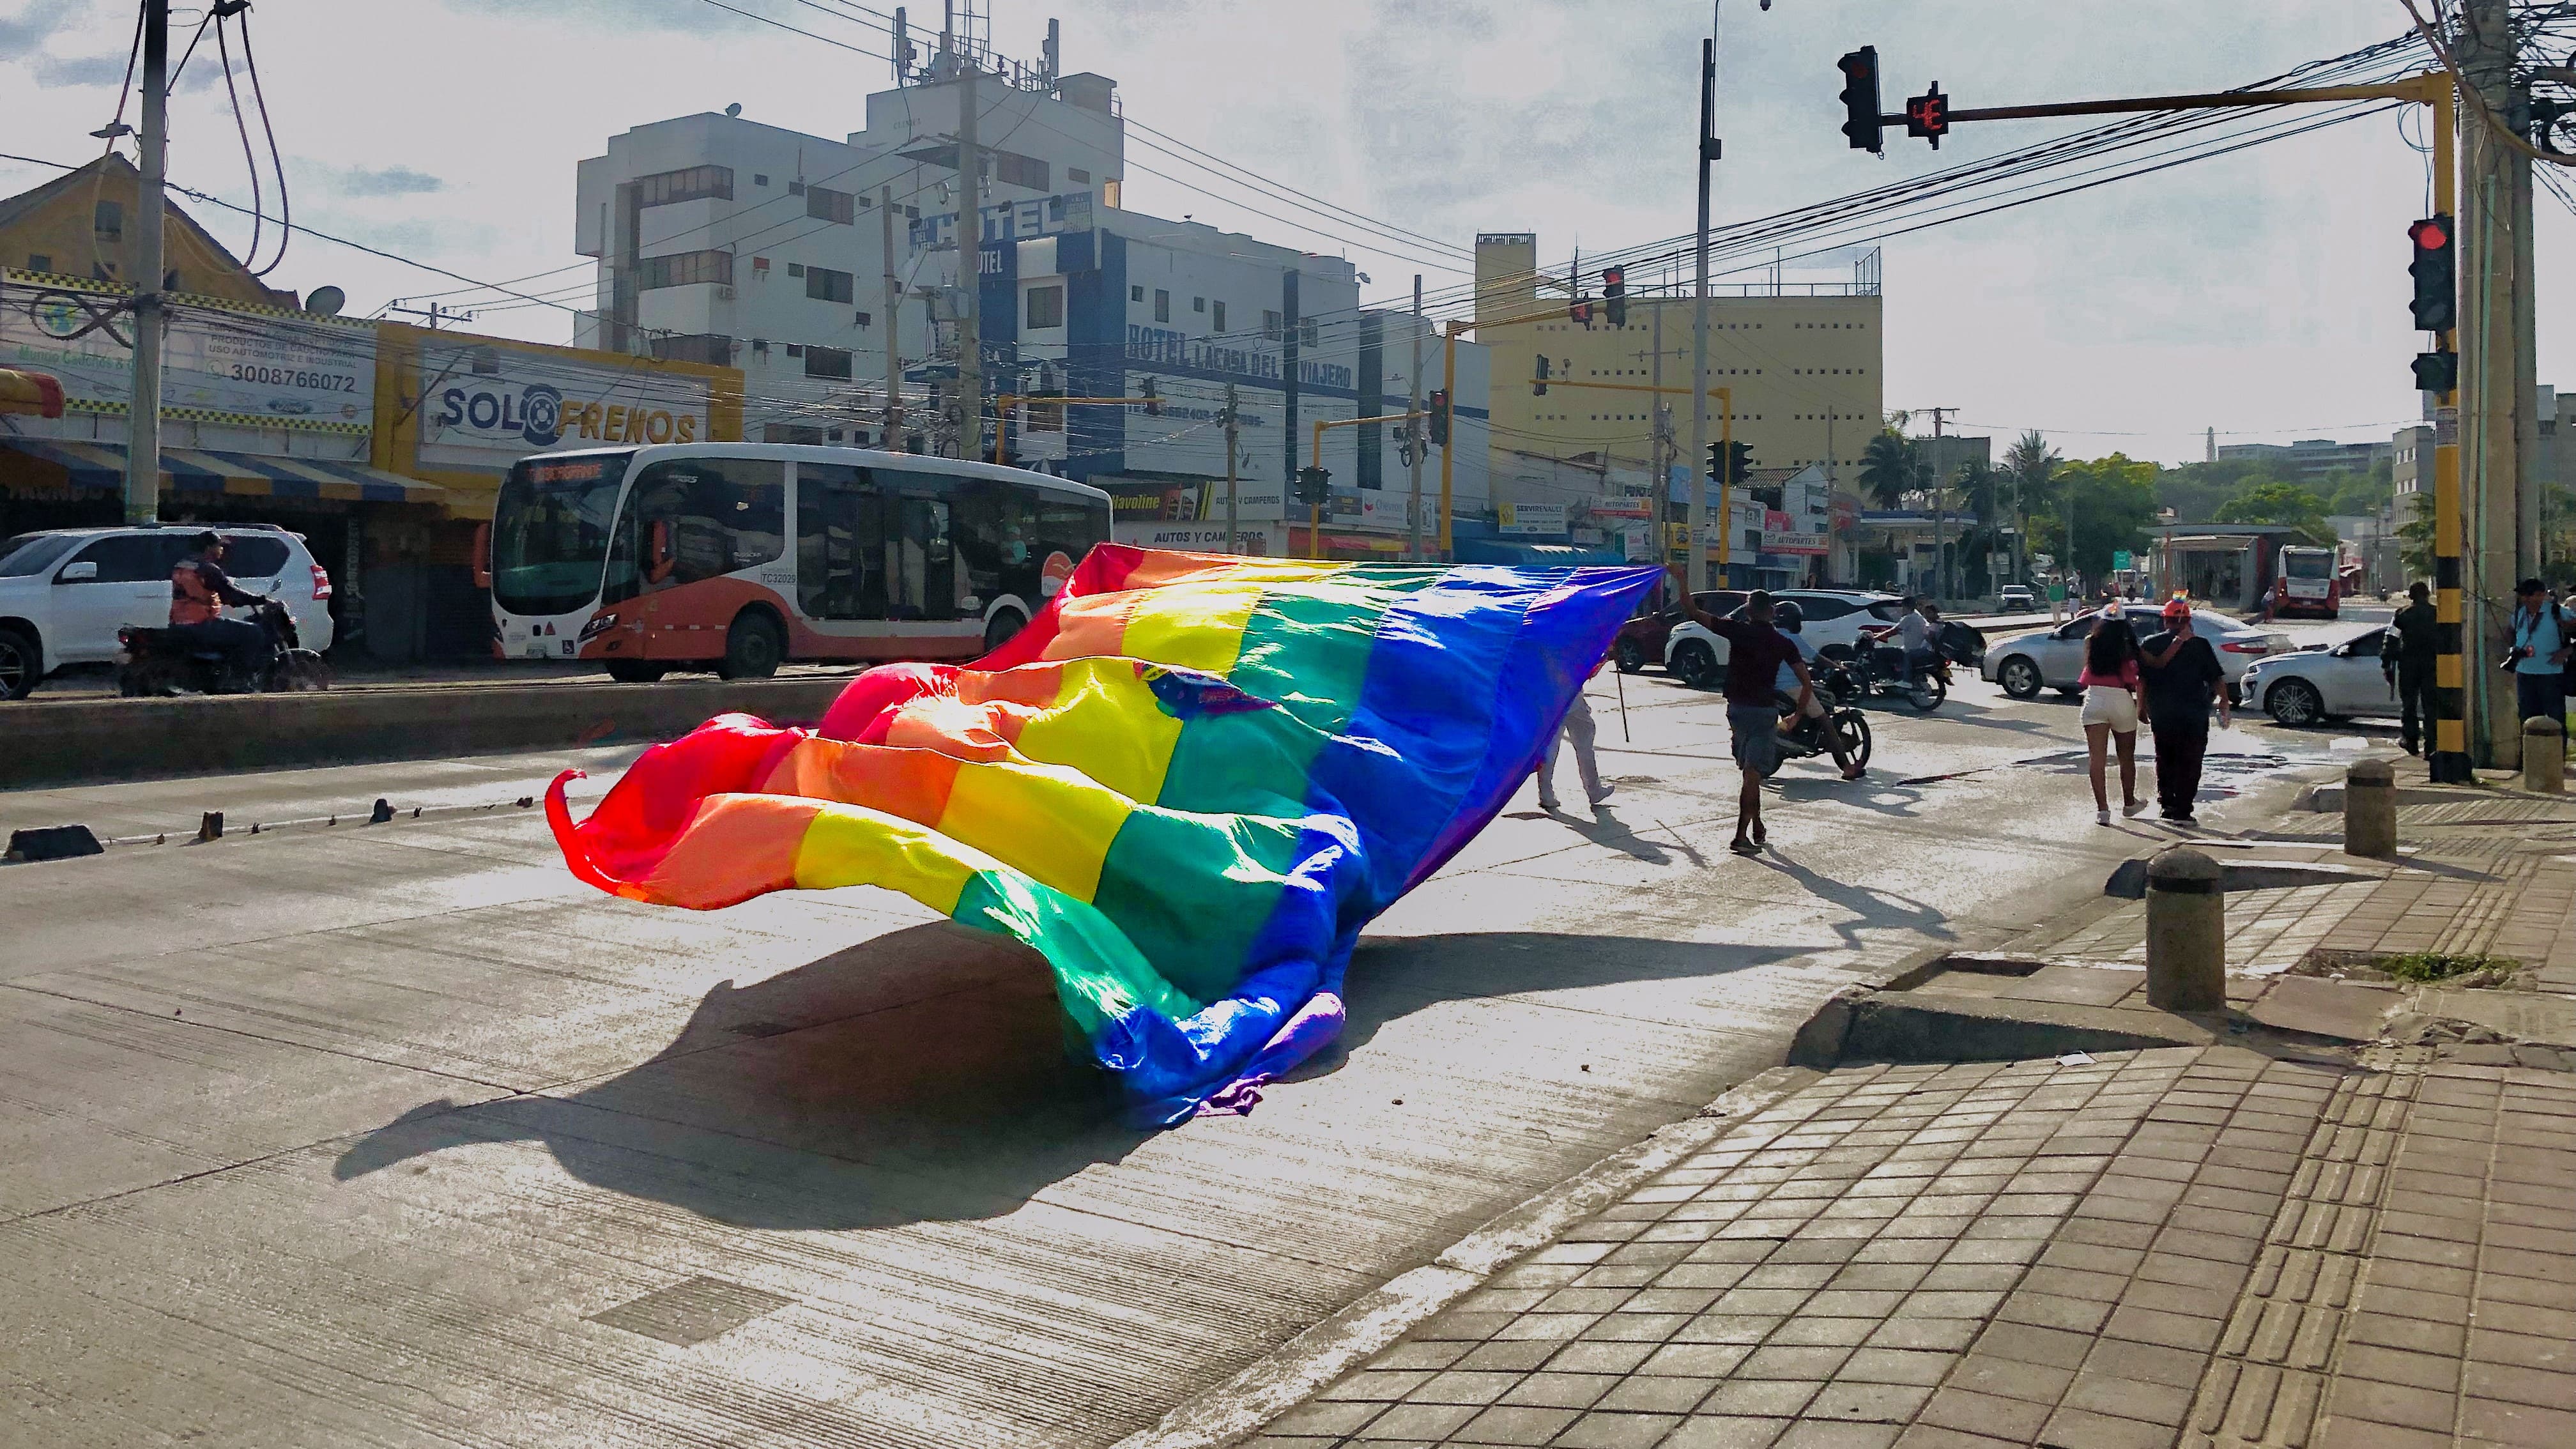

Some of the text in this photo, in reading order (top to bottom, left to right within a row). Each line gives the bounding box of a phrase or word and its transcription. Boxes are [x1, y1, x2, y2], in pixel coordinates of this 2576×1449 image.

[211, 335, 273, 349] PRODUCTOS
[209, 345, 230, 354] USO
[232, 348, 295, 362] AUTOMOTRIZ
[306, 357, 358, 369] INDUSTRIAL
[1128, 324, 1192, 365] HOTEL
[1251, 353, 1279, 379] DEL
[1300, 360, 1351, 388] VIAJERO
[231, 364, 356, 392] 3008766072
[555, 399, 696, 445] FRENOS
[1113, 494, 1160, 510] Havoline
[1244, 496, 1280, 505] CAMPEROS
[1154, 531, 1264, 543] AUTOS Y CAMEROS
[1778, 537, 1816, 545] AUTOPARTES
